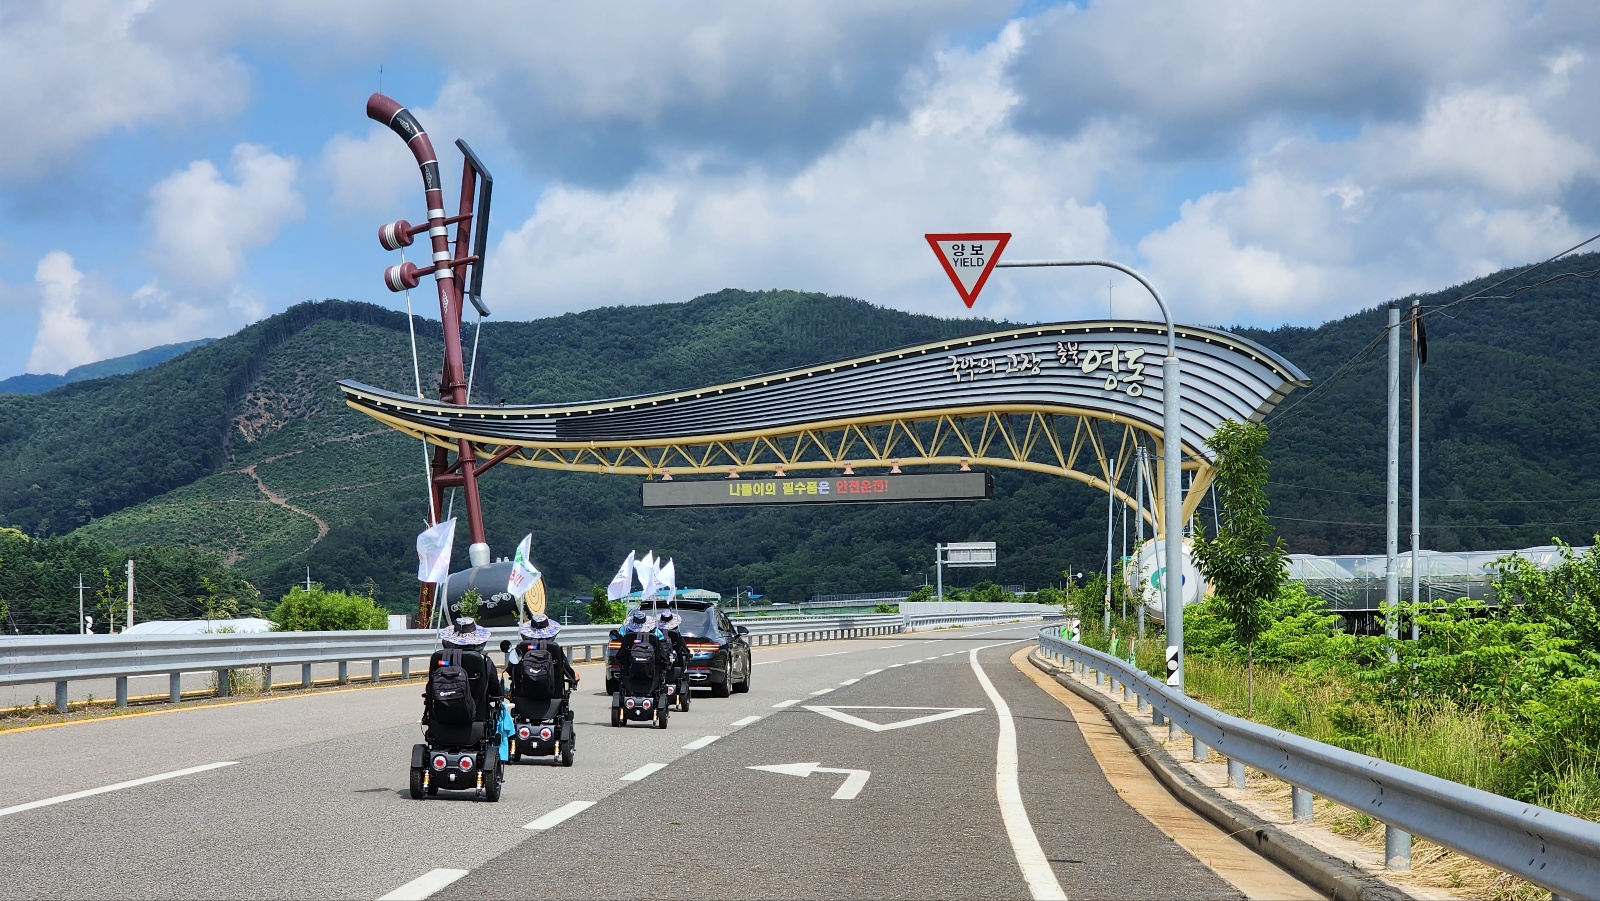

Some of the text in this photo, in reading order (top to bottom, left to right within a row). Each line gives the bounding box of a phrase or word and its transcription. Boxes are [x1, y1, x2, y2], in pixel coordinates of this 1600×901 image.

[952, 257, 985, 267] YIELD
[946, 341, 1146, 397] 국악의 고장 충북 영동
[729, 479, 889, 497] 나들이의 필수품은 안전운전!
